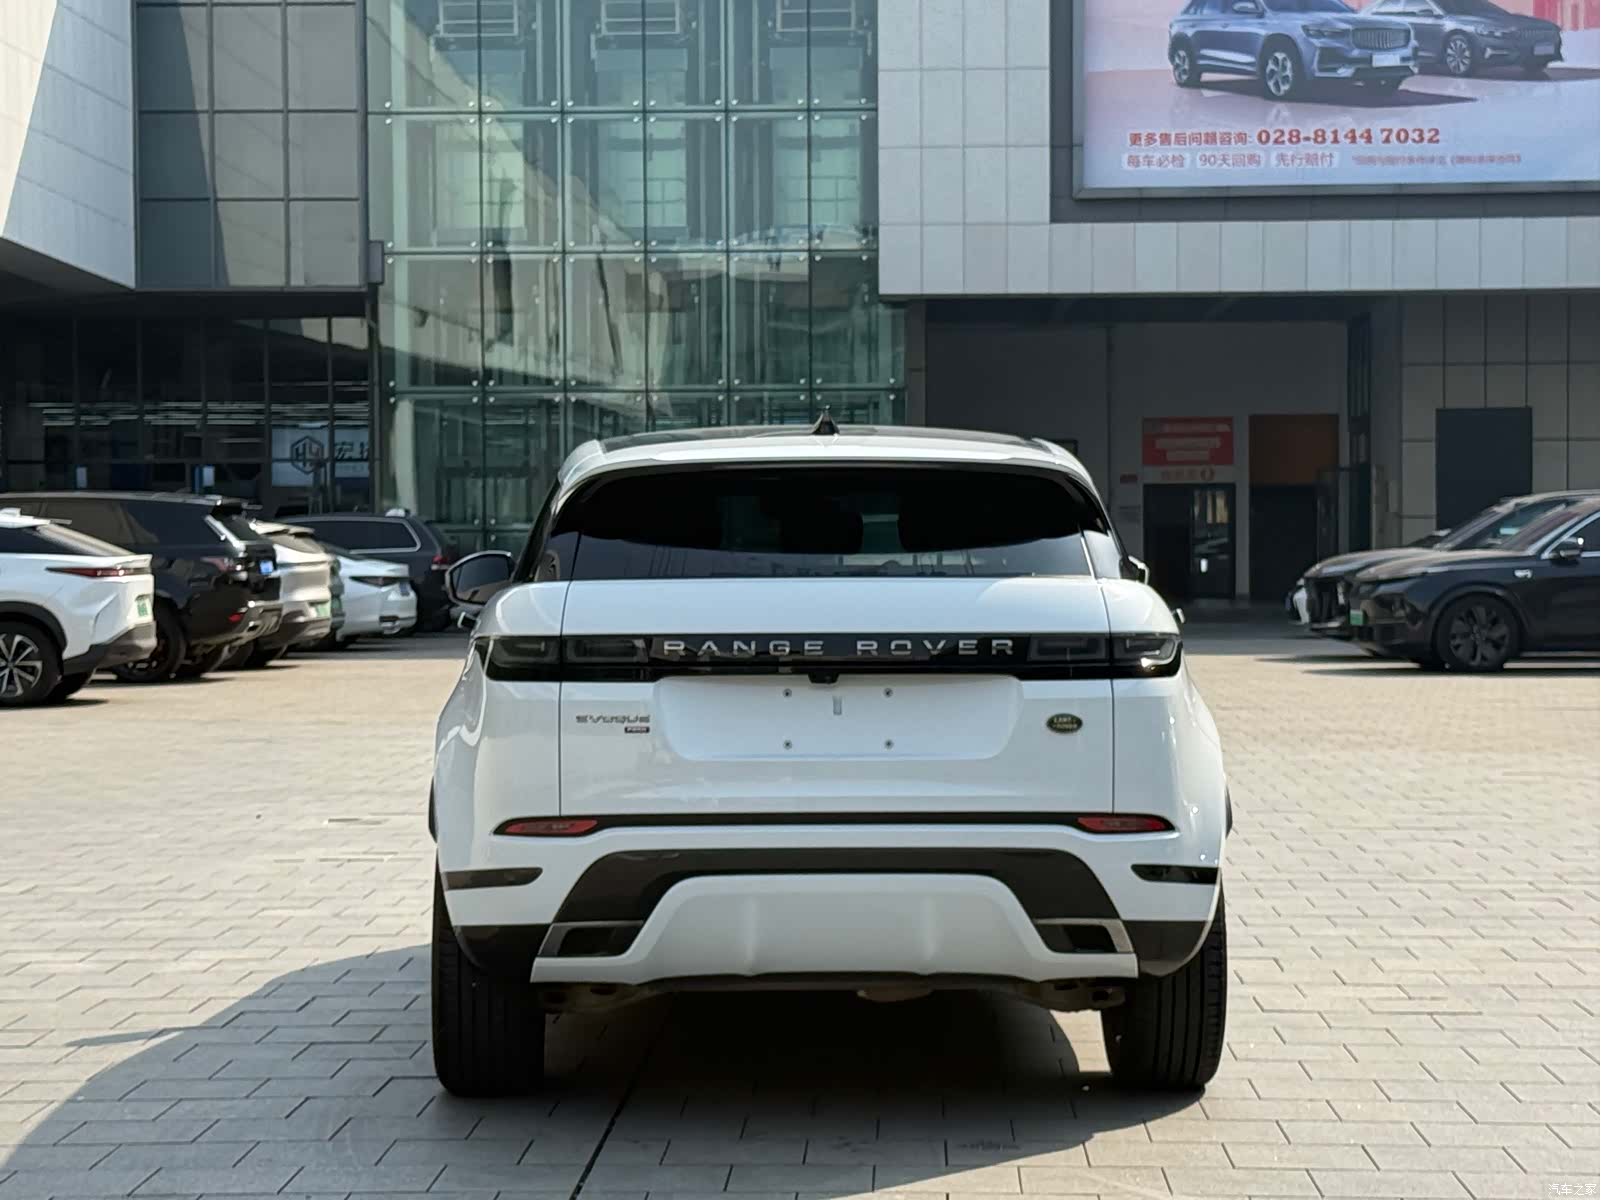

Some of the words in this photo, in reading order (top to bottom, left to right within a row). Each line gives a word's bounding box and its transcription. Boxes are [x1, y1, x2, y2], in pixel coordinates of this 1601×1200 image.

[663, 640, 825, 656] RANGE
[856, 640, 1014, 656] ROVER
[575, 714, 651, 724] EVOQUE
